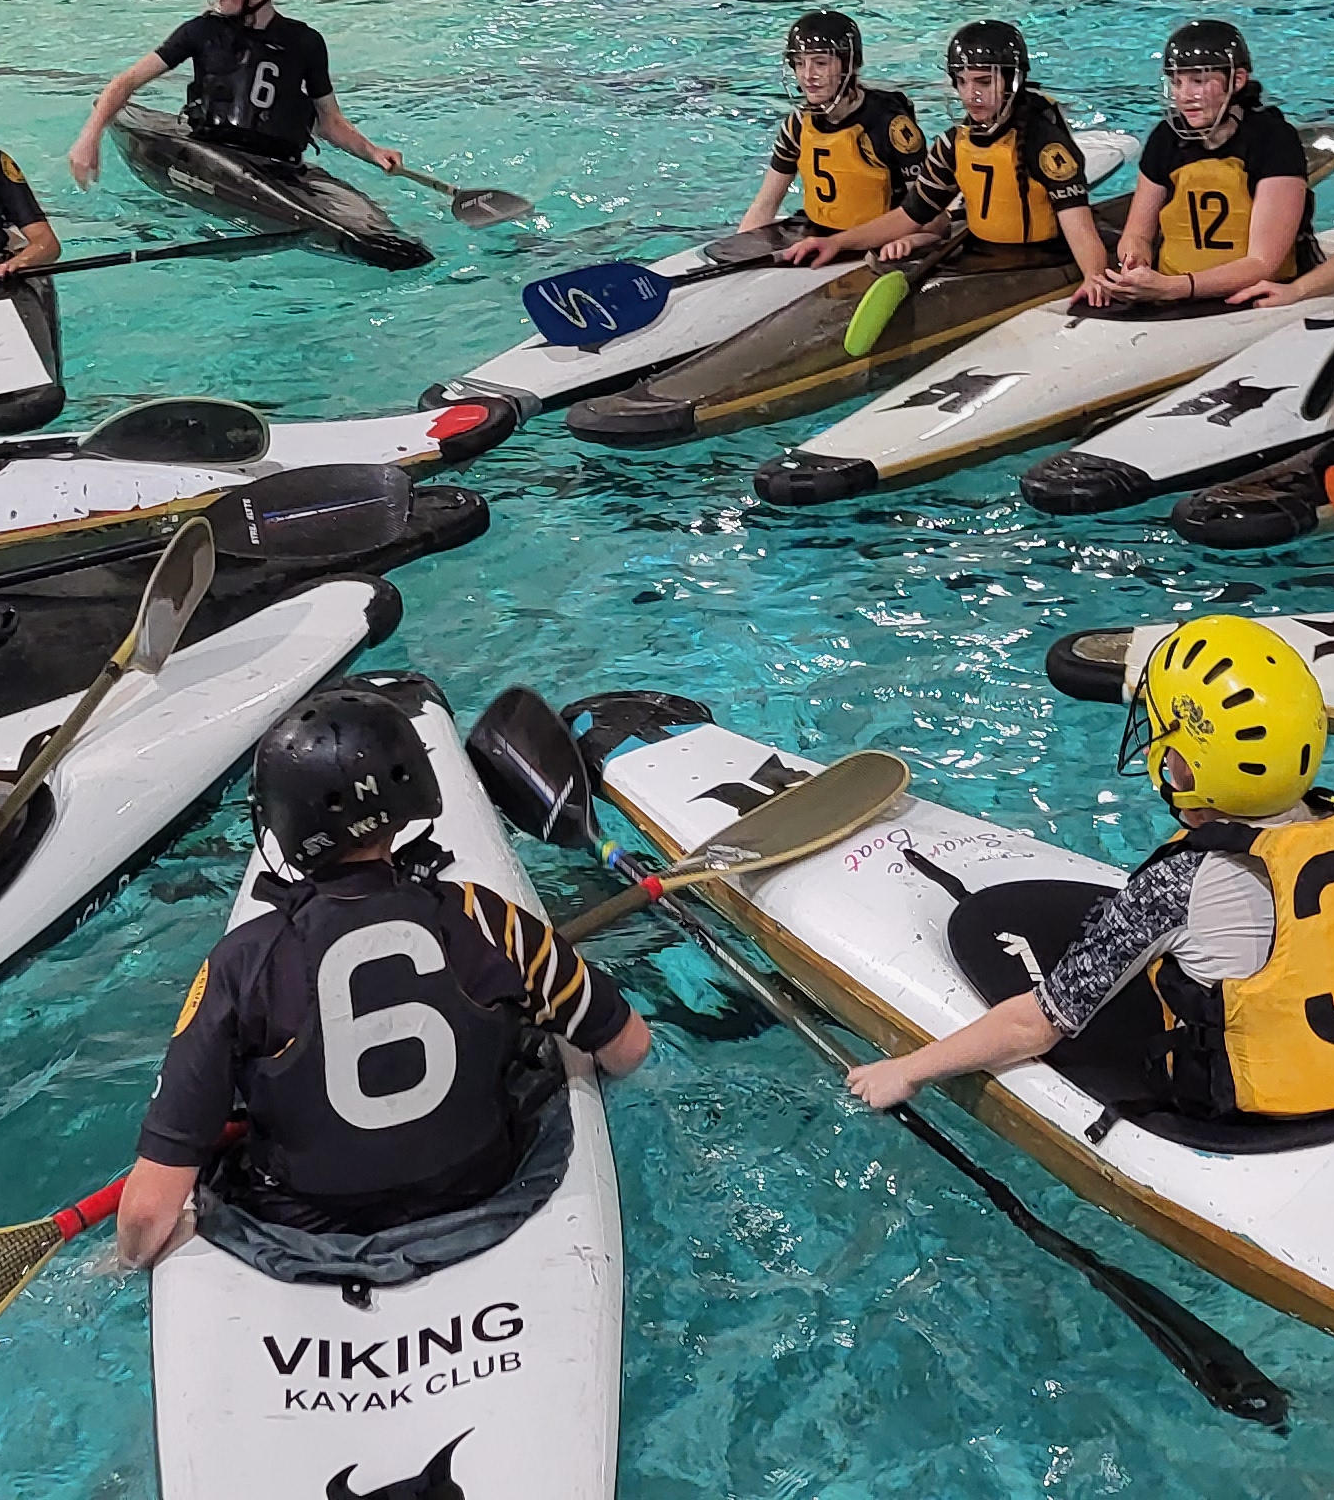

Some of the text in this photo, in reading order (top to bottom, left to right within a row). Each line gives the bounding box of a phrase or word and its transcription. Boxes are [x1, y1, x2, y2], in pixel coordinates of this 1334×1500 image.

[249, 60, 280, 110] 6
[812, 147, 837, 203] 5
[900, 161, 925, 178] HO
[971, 162, 994, 220] 7
[1187, 190, 1234, 250] 12
[843, 828, 920, 873] Boat
[317, 918, 458, 1131] 6
[262, 1301, 525, 1380] VIKING
[284, 1351, 522, 1413] KAYAK CLUB
